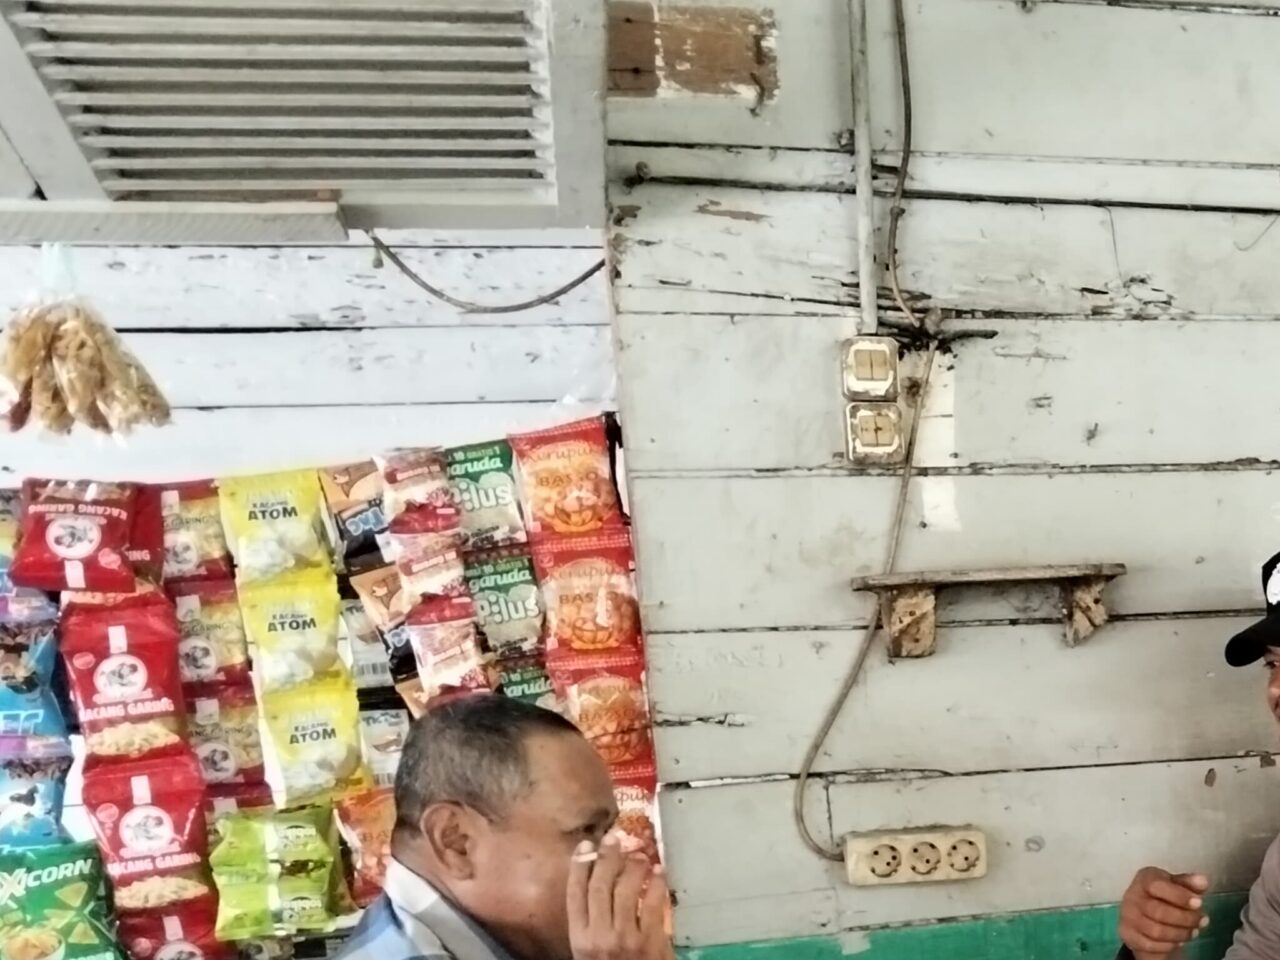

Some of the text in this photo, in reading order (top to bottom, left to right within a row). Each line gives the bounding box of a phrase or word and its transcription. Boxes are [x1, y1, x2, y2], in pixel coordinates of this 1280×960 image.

[447, 456, 503, 478] aruda
[248, 505, 299, 522] ATOM
[468, 568, 532, 593] garuda
[267, 617, 317, 632] ATOM
[289, 727, 337, 745] ATOM
